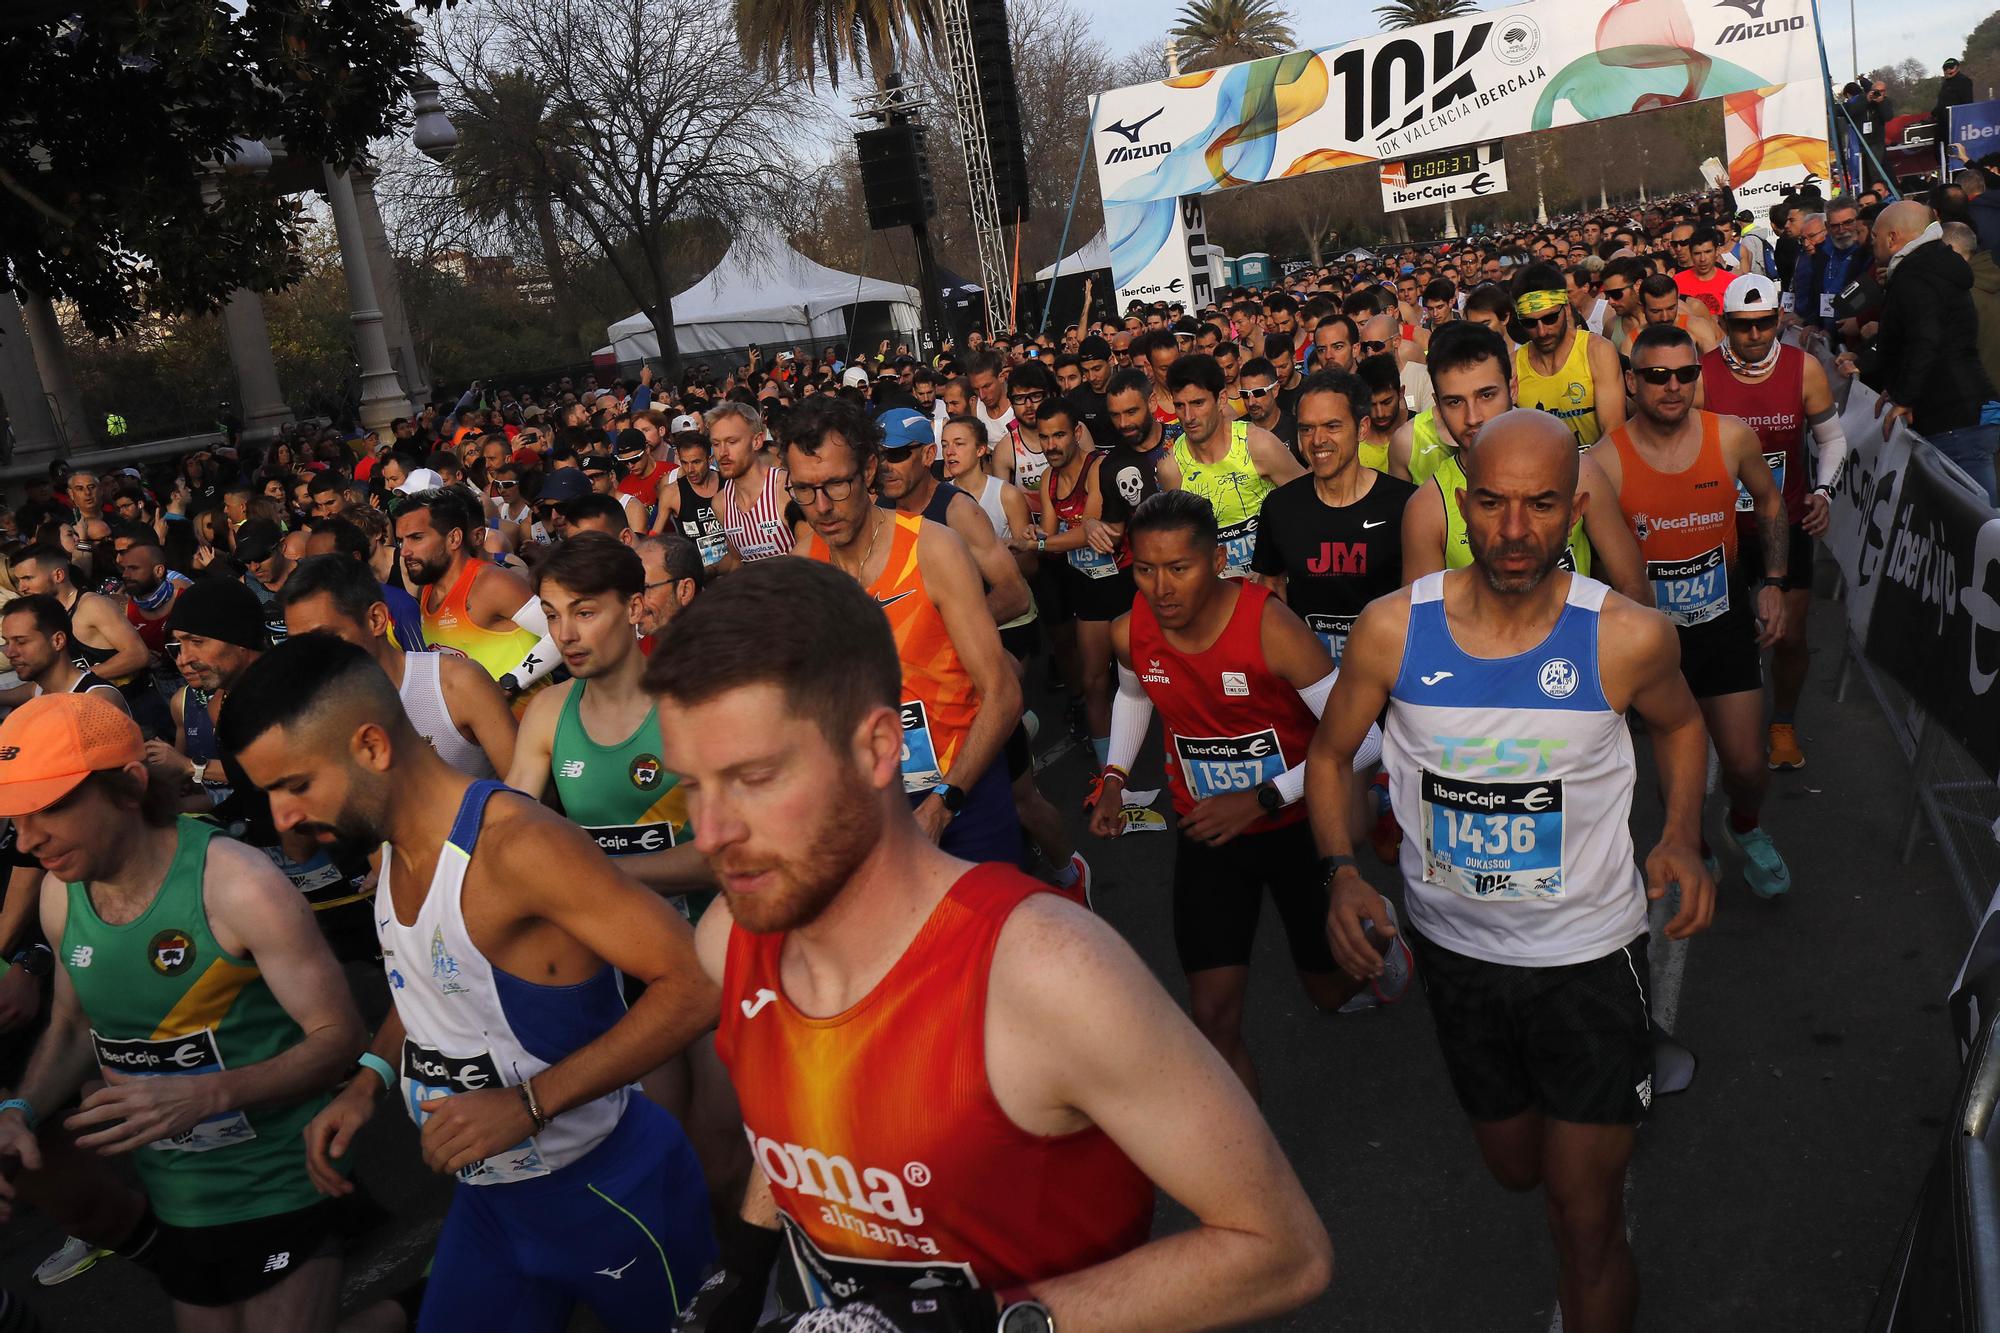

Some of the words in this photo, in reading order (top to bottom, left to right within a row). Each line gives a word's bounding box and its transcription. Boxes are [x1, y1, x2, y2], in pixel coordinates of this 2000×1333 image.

[1333, 21, 1493, 142] 10K
[1377, 136, 1401, 157] 10K
[1403, 102, 1471, 144] VALENCIA
[1474, 65, 1546, 109] IBERCAJA
[1393, 183, 1456, 204] iberCaja
[1121, 285, 1161, 298] iberCaja
[1306, 542, 1367, 573] JM
[1657, 563, 1702, 576] iberCaja
[1664, 569, 1715, 603] 1247
[1186, 744, 1238, 757] iberCaja
[1199, 760, 1263, 790] 1357
[1433, 783, 1506, 809] iberCaja
[594, 835, 628, 850] Caja
[1443, 809, 1536, 855] 1436
[1465, 857, 1511, 870] OUKASSOU
[1474, 874, 1512, 895] 10K
[820, 1203, 940, 1256] almansa
